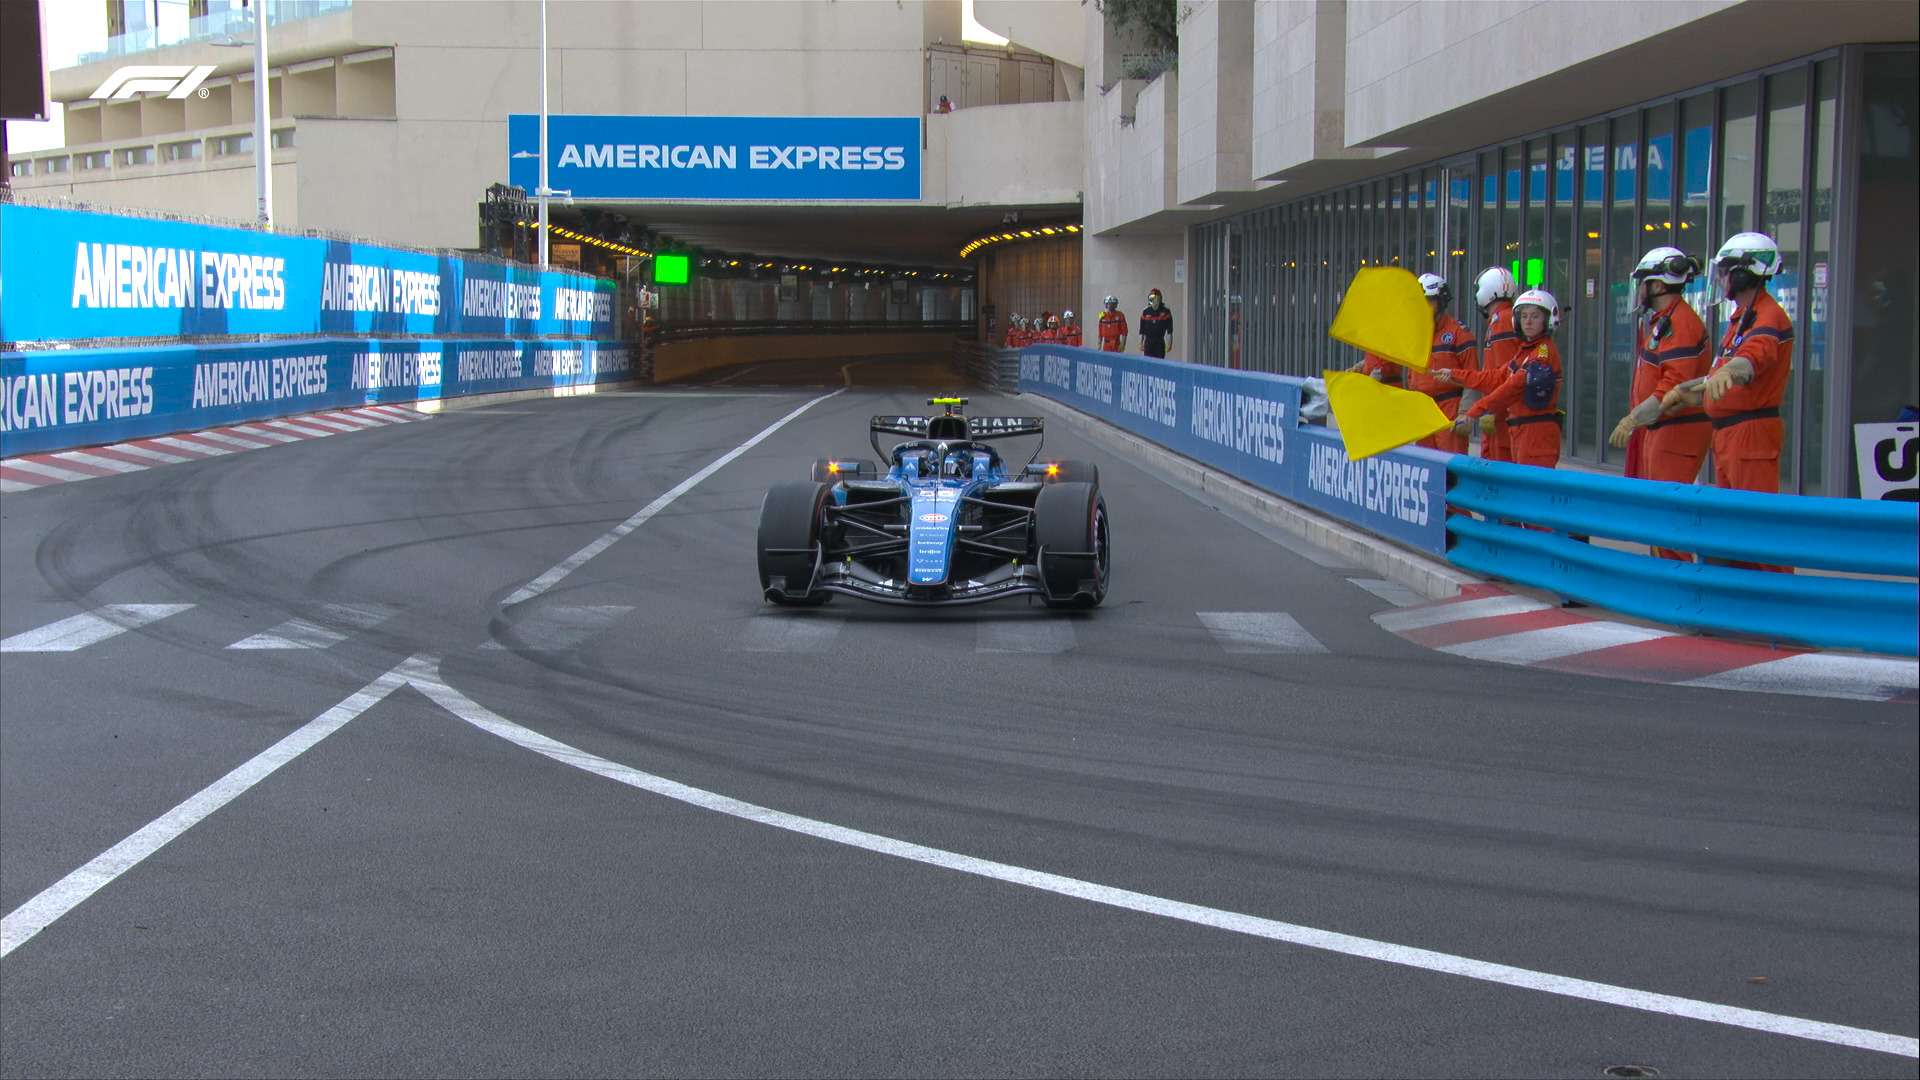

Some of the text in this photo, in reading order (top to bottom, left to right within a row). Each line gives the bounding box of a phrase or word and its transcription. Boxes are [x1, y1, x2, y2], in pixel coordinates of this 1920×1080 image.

[558, 144, 906, 170] AMERICAN EXPRESS
[72, 242, 286, 310] AMERICAN EXPRESS
[321, 262, 441, 316] AMERICAN EXPRESS
[463, 278, 541, 320] AMERICAN EXPRESS
[555, 287, 587, 320] AMERICAN
[588, 291, 610, 322] EXPRESS
[192, 355, 329, 409] AMERICAN EXPRESS
[352, 352, 441, 390] AMERICAN EXPRESS
[458, 350, 522, 382] AMERICAN EXPRESS
[534, 350, 583, 376] AMERICAN EXPRESS
[1076, 361, 1094, 398] AMERICAN
[1094, 364, 1112, 405] EXPRESS
[64, 367, 153, 424] EXPRESS
[1121, 371, 1177, 428] AMERICAN EXPRESS
[1191, 386, 1285, 465] AMERICAN EXPRESS
[1308, 442, 1430, 526] AMERICAN EXPRESS
